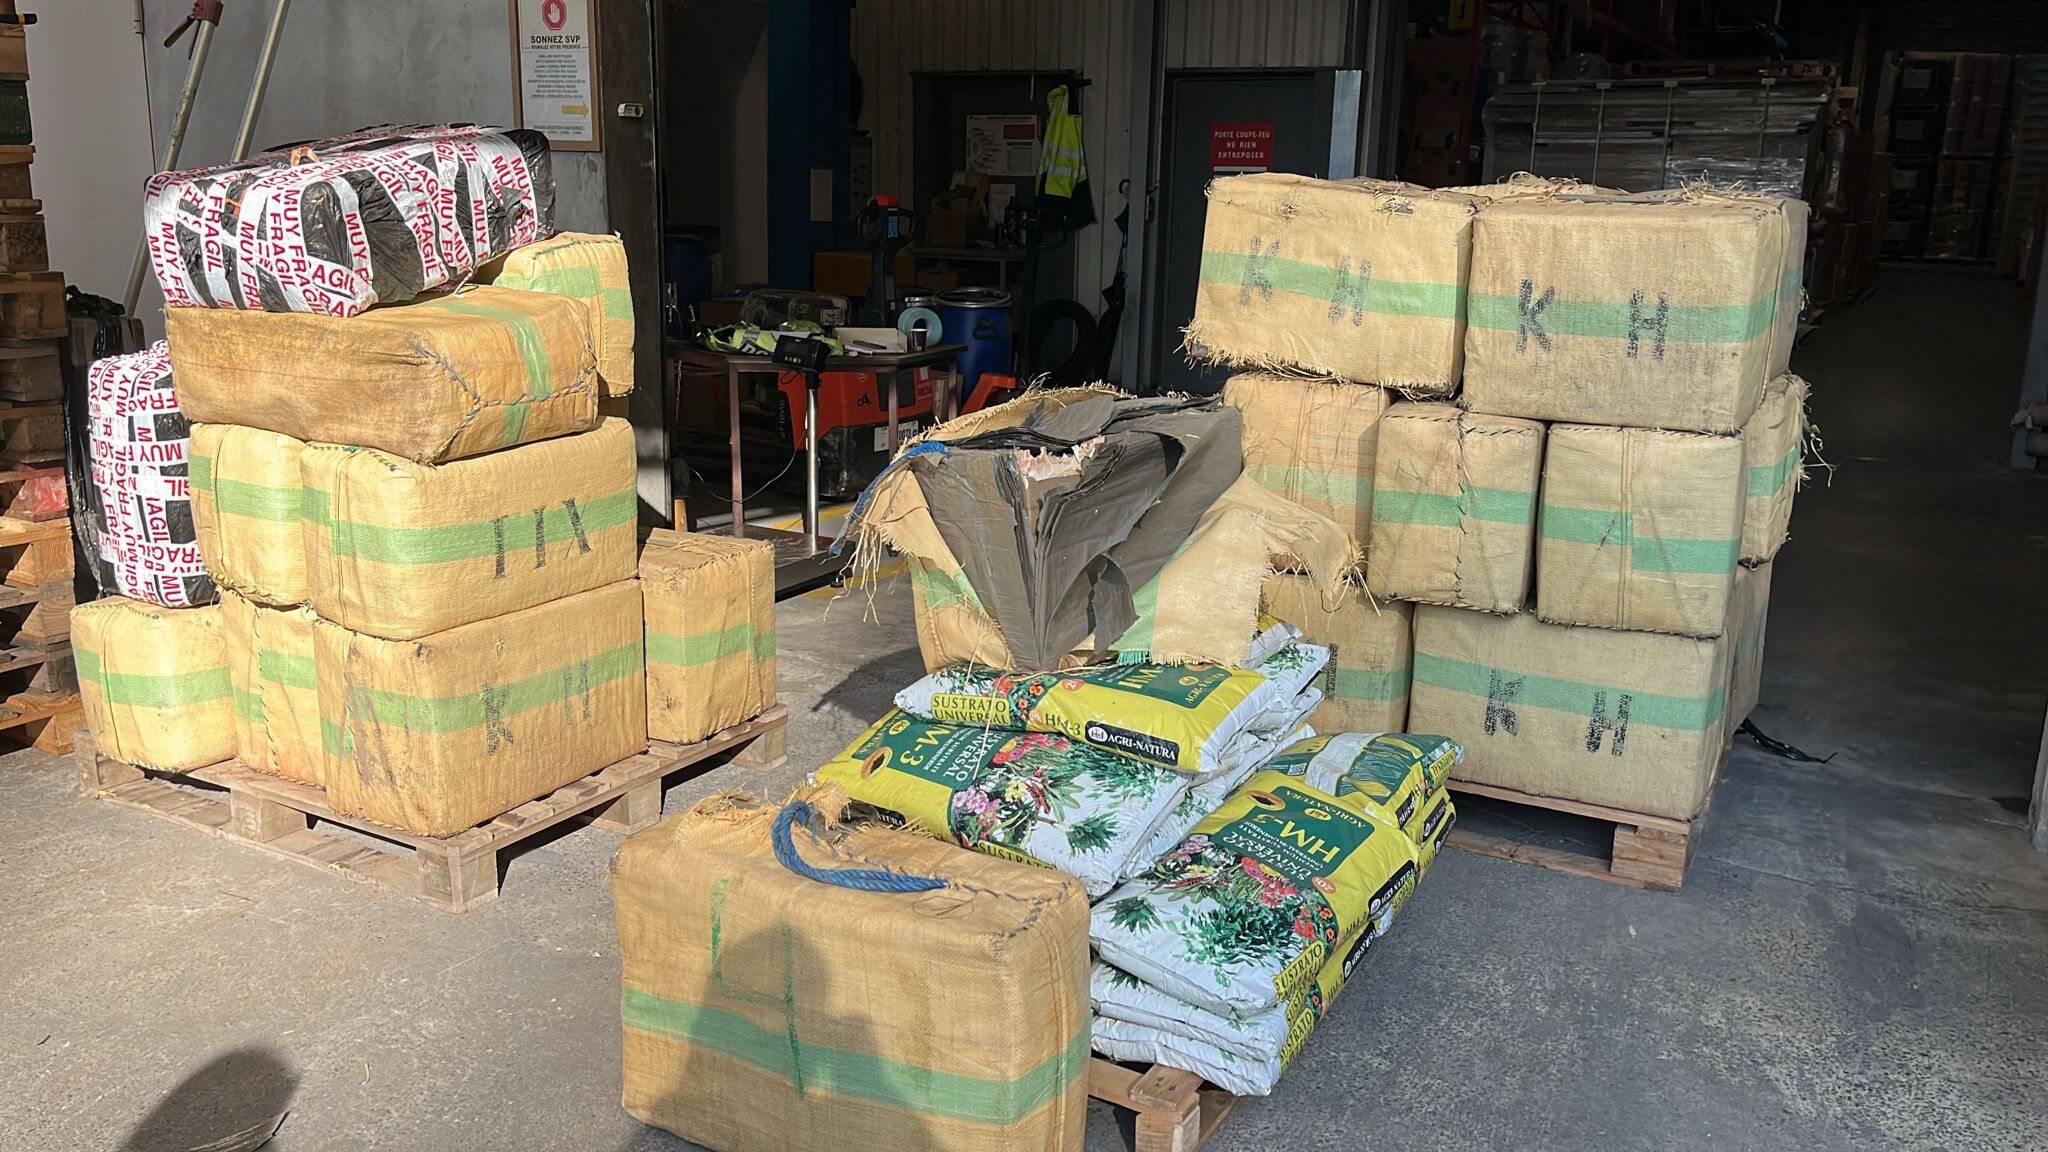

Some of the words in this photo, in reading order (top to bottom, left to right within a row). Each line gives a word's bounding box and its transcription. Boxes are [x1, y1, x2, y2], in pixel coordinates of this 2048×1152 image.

[530, 35, 563, 44] SONNEZ
[565, 34, 581, 43] SVP
[511, 157, 532, 201] MUY
[205, 195, 224, 273] FRAGIL
[283, 189, 301, 237] MUY
[440, 188, 454, 234] MUY
[472, 199, 487, 245] MUY
[161, 222, 180, 269] MUY
[240, 220, 257, 268] MUY
[270, 212, 295, 291] FRAGIL
[345, 212, 367, 260] MUY
[416, 200, 438, 277] FRAGIL
[288, 245, 322, 314] FRAGIL
[1239, 234, 1280, 306] K
[1328, 252, 1372, 327] H
[1516, 278, 1555, 355] K
[1627, 287, 1669, 361] H
[102, 365, 121, 402] MUY
[115, 374, 132, 418] MUY
[140, 442, 183, 462] MUY
[932, 694, 1007, 713] SUSTRATO
[934, 708, 1009, 725] UNIVERSAL
[1044, 713, 1081, 737] HM-3
[1484, 668, 1526, 737] K
[1586, 690, 1632, 757] H
[1222, 836, 1309, 881] SUSTRATO
[1231, 831, 1312, 876] UNIVERSAL
[1252, 813, 1341, 864] HM-3
[1273, 944, 1323, 991] SUSTRATO
